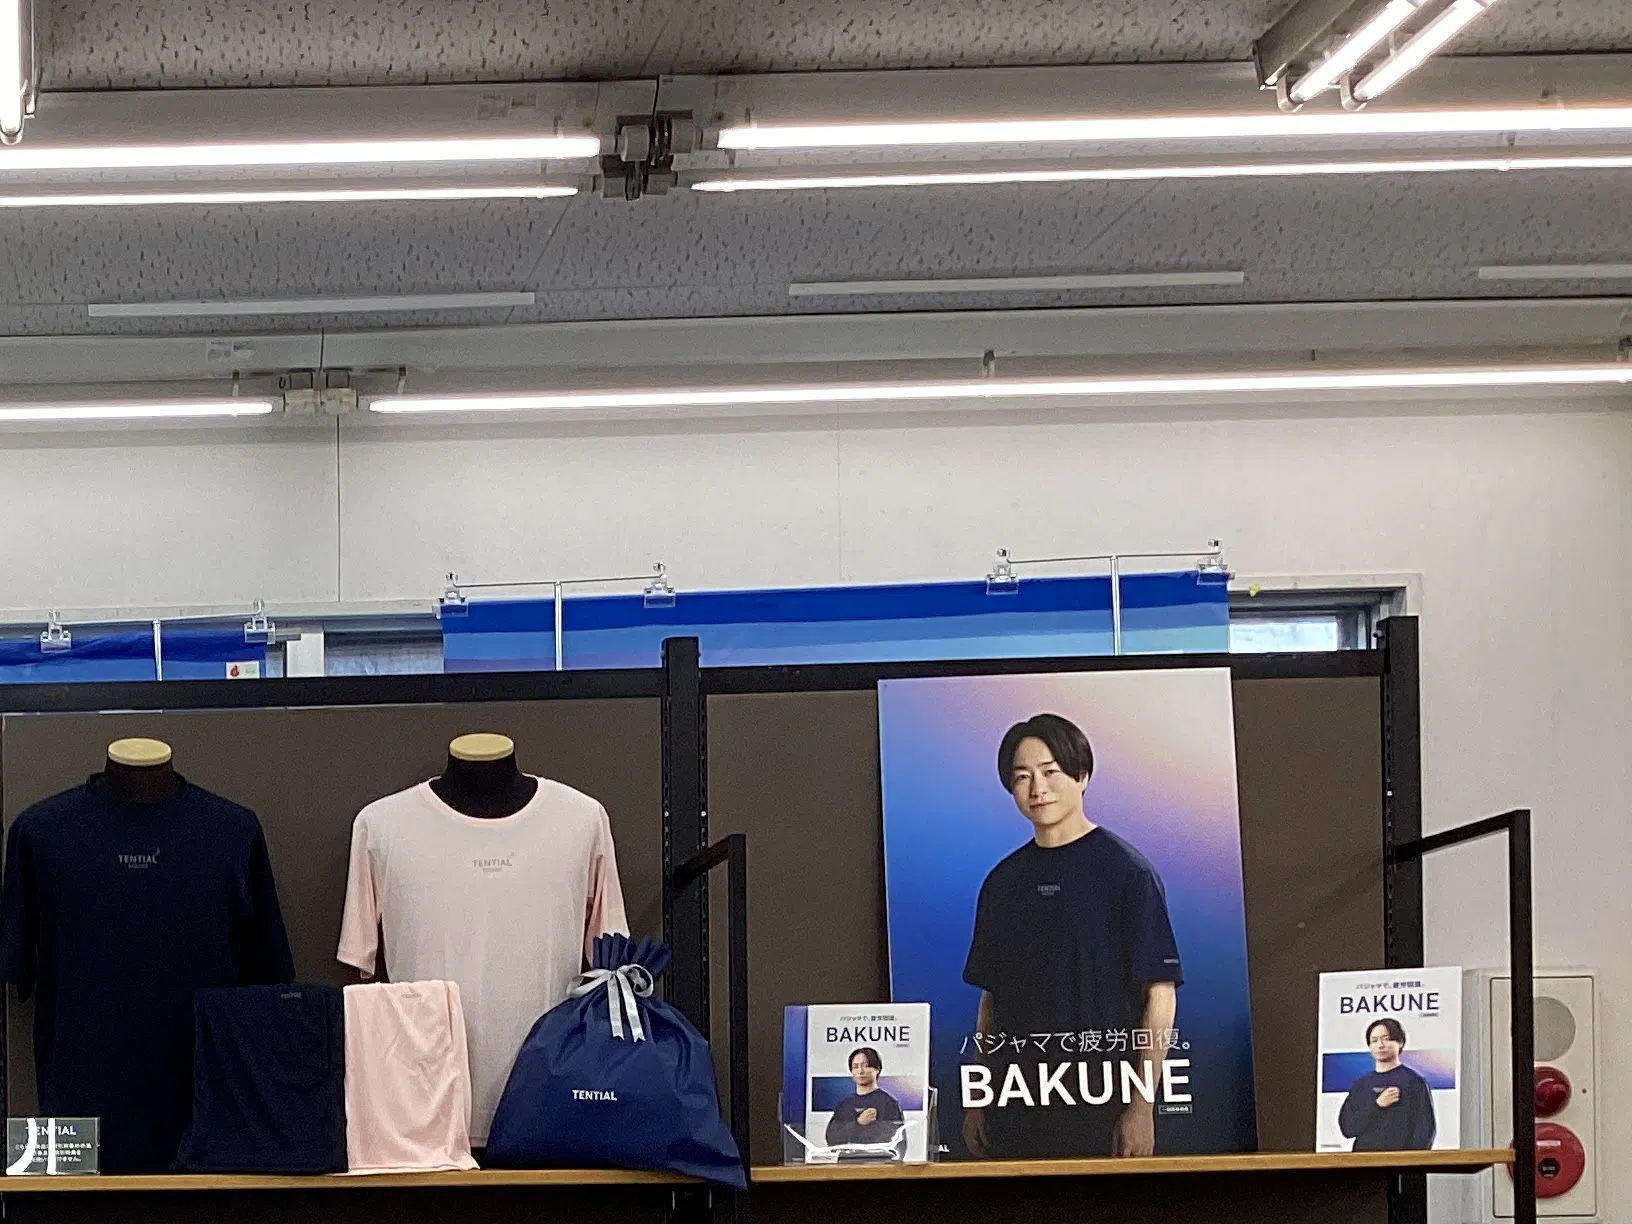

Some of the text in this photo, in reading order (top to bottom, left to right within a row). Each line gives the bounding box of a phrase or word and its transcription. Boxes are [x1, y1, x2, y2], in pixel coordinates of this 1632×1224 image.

[1340, 992, 1440, 1014] BAKUNE
[826, 1026, 910, 1042] BAKUNE
[960, 1028, 1191, 1055] パジャマで疲労回復。
[960, 1059, 1193, 1108] BAKUNE
[571, 1089, 618, 1102] TENTIAL
